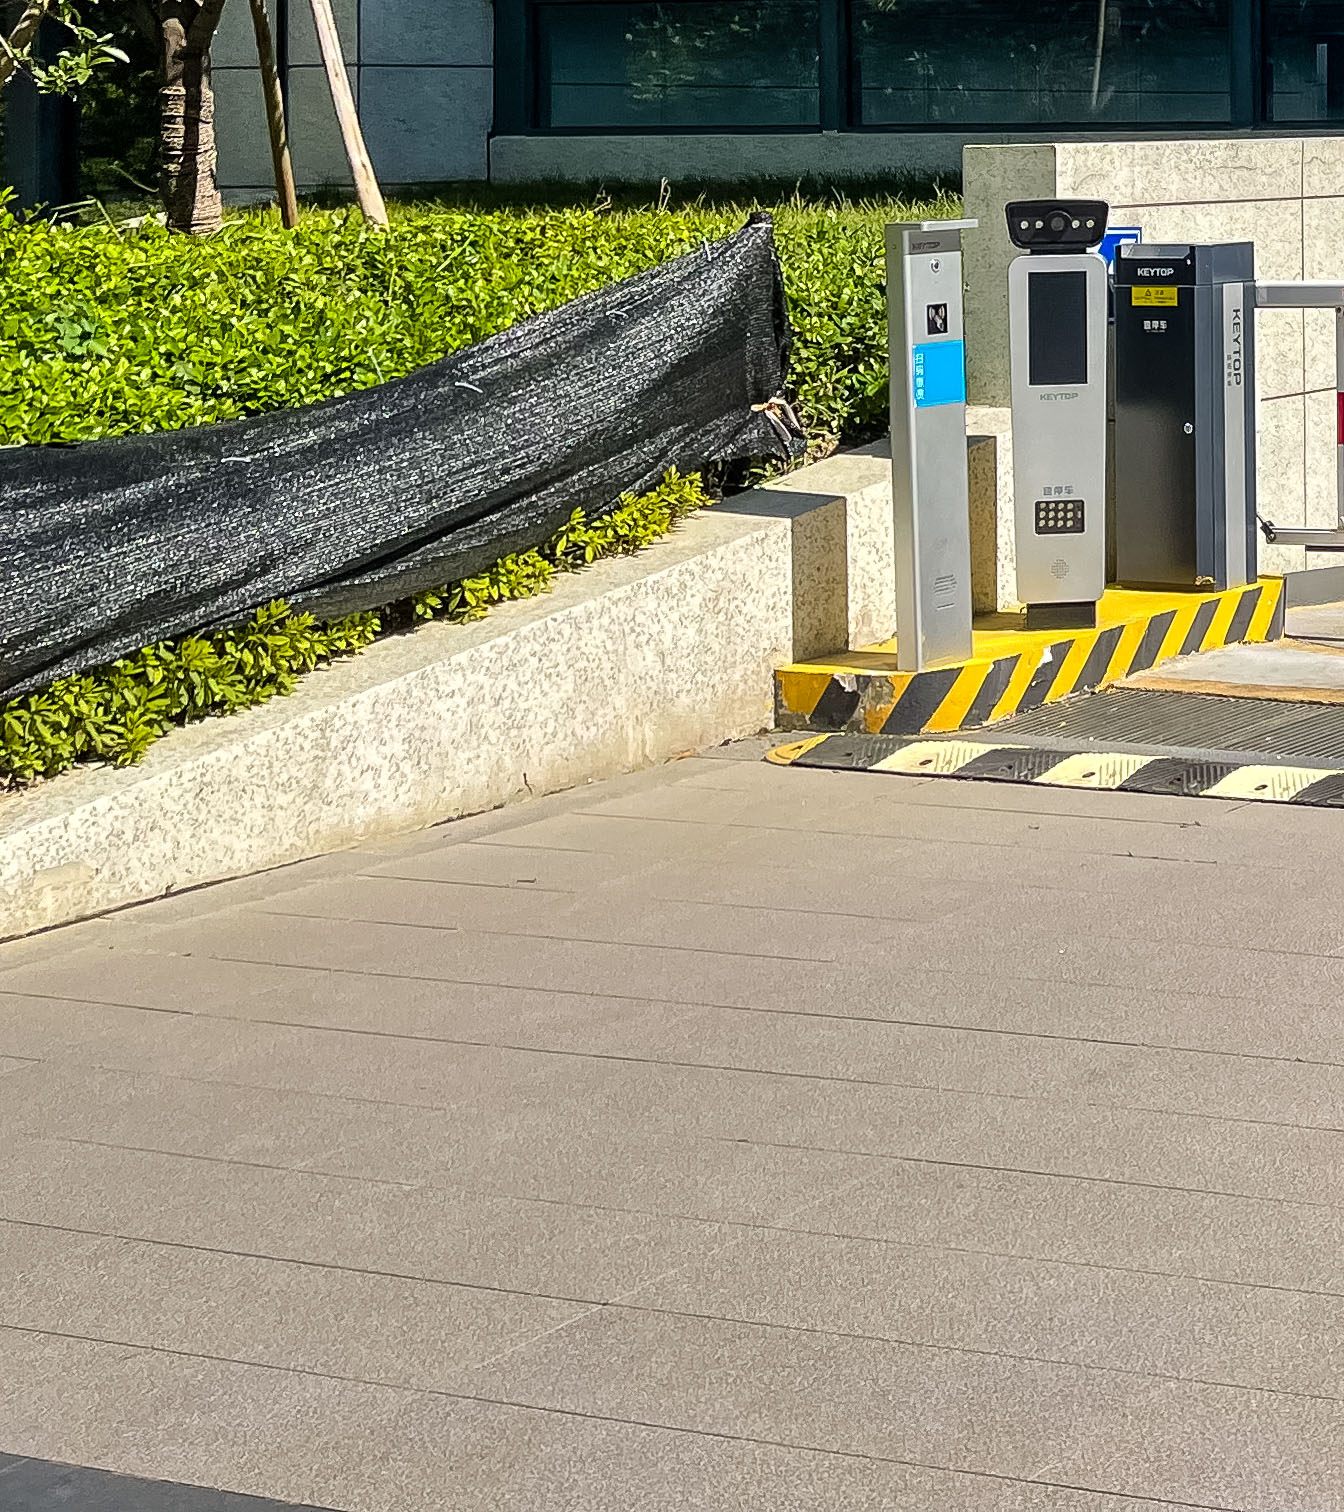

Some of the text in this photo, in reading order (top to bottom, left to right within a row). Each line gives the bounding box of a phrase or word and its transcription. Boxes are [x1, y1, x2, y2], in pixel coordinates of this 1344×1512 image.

[1137, 268, 1174, 277] KEYTOP
[1232, 308, 1242, 386] KEYTOP
[1039, 392, 1079, 401] KEYTOP
